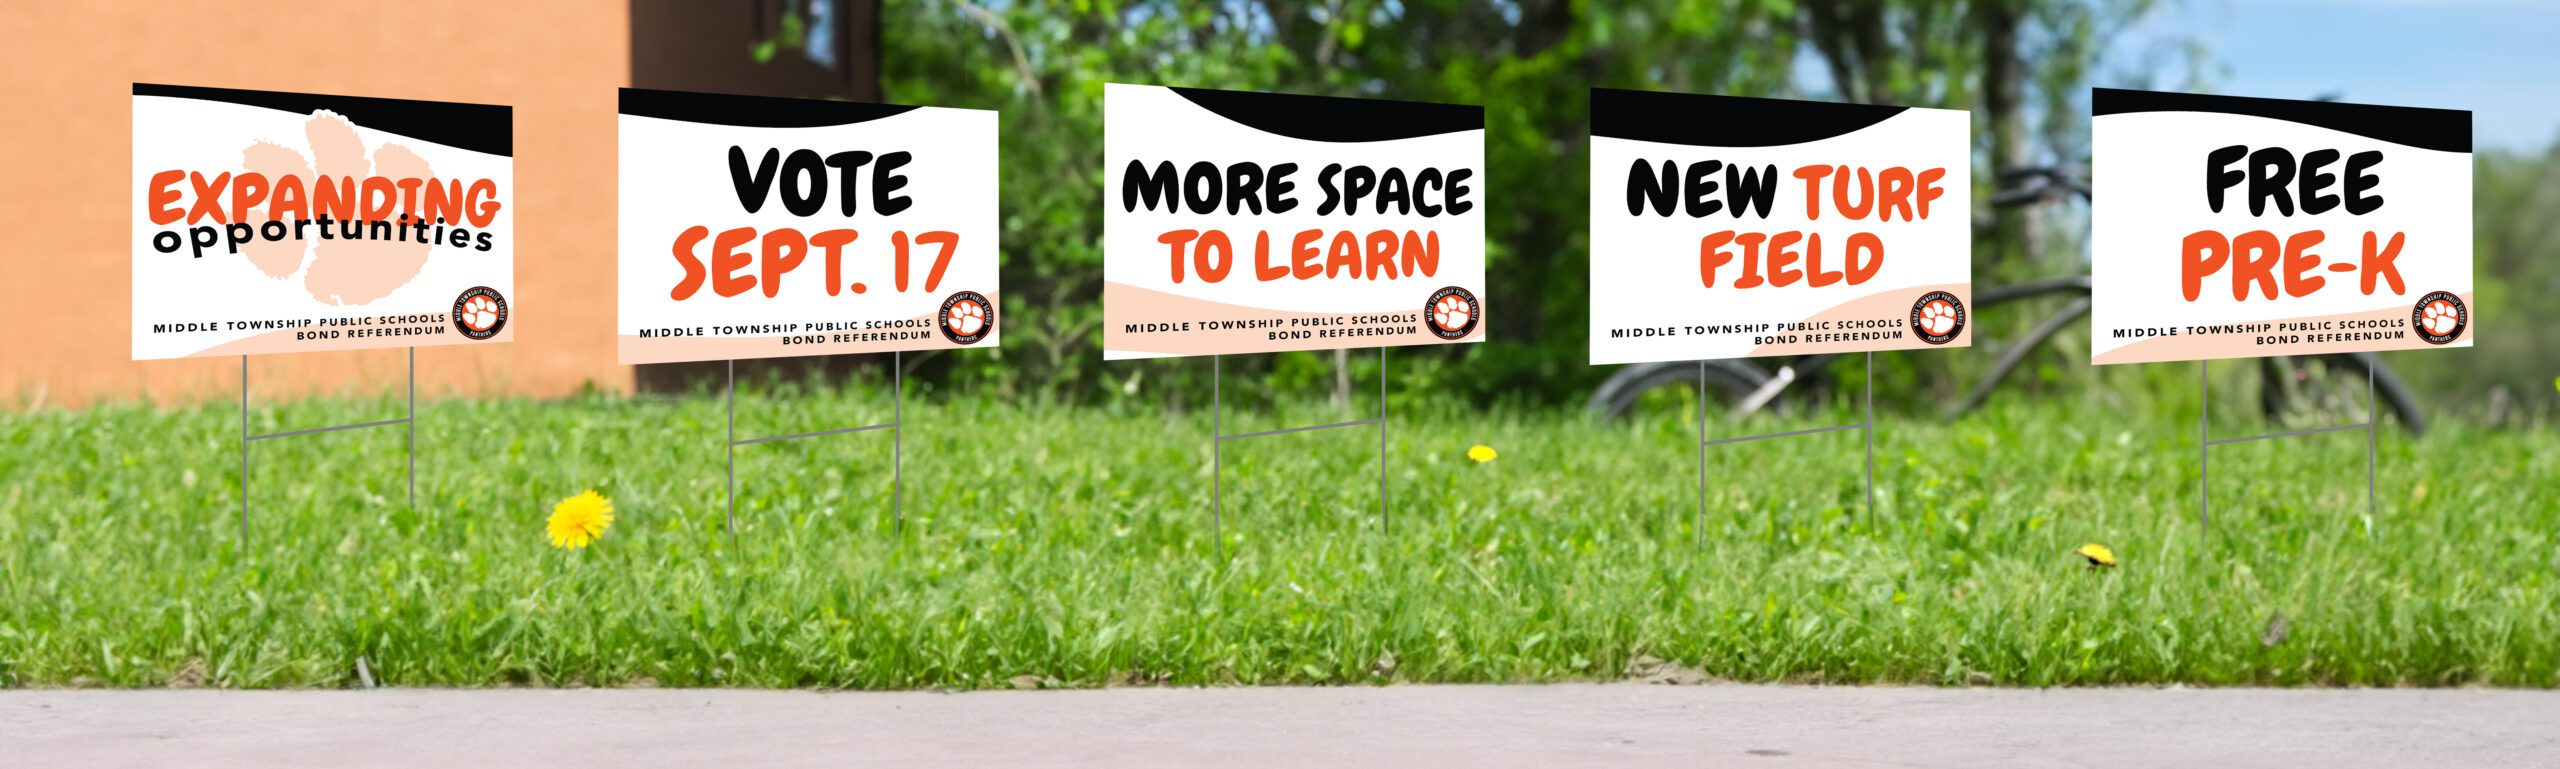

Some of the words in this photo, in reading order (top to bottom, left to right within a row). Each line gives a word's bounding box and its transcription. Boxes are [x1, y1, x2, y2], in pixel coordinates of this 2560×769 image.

[728, 146, 913, 217] VOTE
[1122, 160, 1299, 215] MORE
[1316, 163, 1474, 217] SPACE
[1626, 159, 1778, 219] NEW
[1792, 165, 1946, 221] TURF
[2206, 145, 2384, 217] FREE
[148, 170, 502, 228] EXPANDING
[152, 214, 493, 258] opportunities
[670, 226, 867, 300] SEPT.
[891, 231, 960, 292] 17
[1157, 230, 1233, 283] TO
[1254, 229, 1440, 281] LEARN
[1700, 231, 1884, 288] FIELD
[2181, 230, 2406, 301] PRE-K
[153, 322, 218, 334] MIDDLE
[226, 318, 312, 331] TOWNSHIP
[319, 316, 372, 327] PUBLIC
[379, 314, 445, 325] SCHOOLS
[297, 330, 340, 341] BOND
[348, 326, 444, 337] REFERENDUM
[639, 327, 704, 338] MIDDLE
[712, 323, 798, 335] TOWNSHIP
[805, 321, 858, 332] PUBLIC
[865, 318, 931, 330] SCHOOLS
[783, 335, 826, 345] BOND
[834, 331, 930, 342] REFERENDUM
[1125, 322, 1190, 333] MIDDLE
[1198, 319, 1284, 331] TOWNSHIP
[1291, 316, 1344, 327] PUBLIC
[1351, 314, 1417, 325] SCHOOLS
[1268, 330, 1312, 341] BOND
[1320, 326, 1416, 337] REFERENDUM
[1611, 327, 1676, 338] MIDDLE
[1684, 323, 1769, 336] TOWNSHIP
[1777, 321, 1829, 332] PUBLIC
[1837, 318, 1903, 330] SCHOOLS
[1754, 335, 1798, 345] BOND
[1806, 331, 1902, 342] REFERENDUM
[2113, 327, 2177, 338] MIDDLE
[2186, 323, 2271, 335] TOWNSHIP
[2279, 321, 2331, 332] PUBLIC
[2339, 318, 2404, 330] SCHOOLS
[2256, 335, 2299, 345] BOND
[2307, 331, 2403, 342] REFERENDUM
